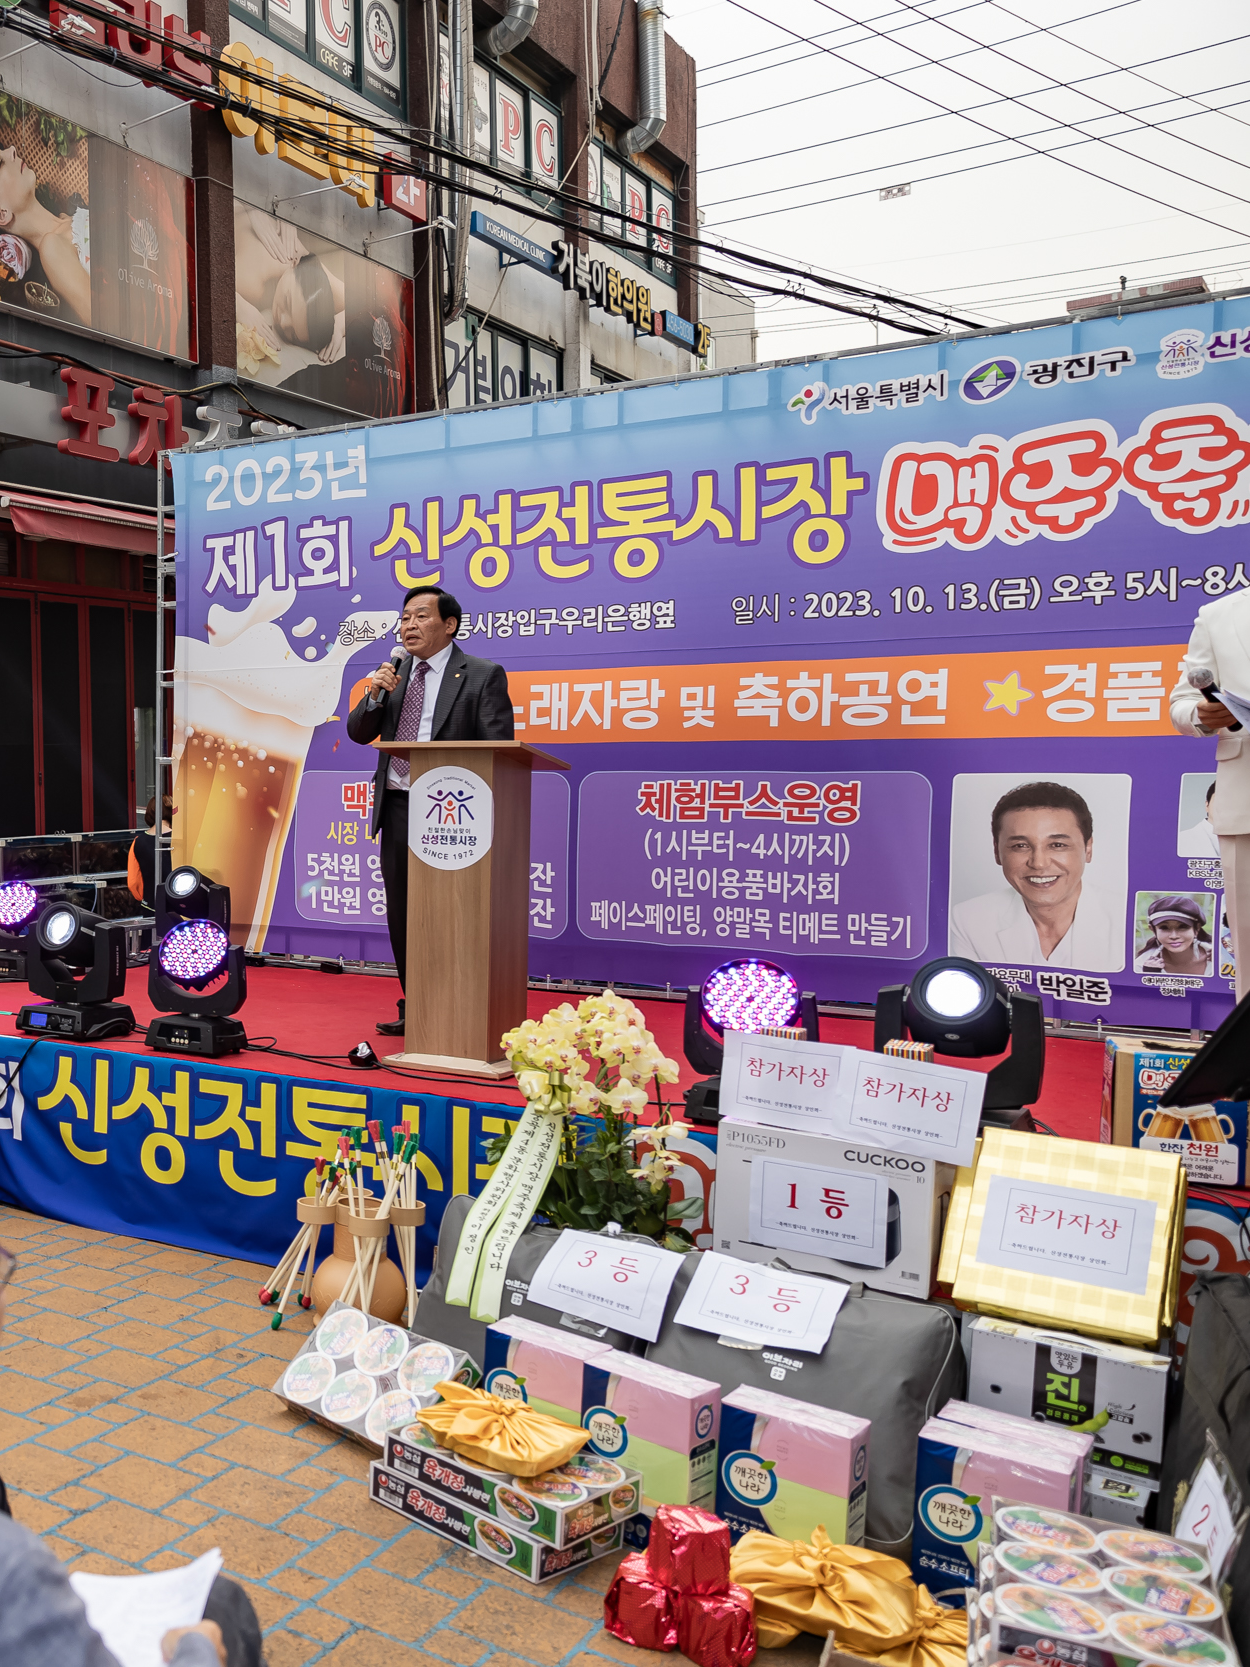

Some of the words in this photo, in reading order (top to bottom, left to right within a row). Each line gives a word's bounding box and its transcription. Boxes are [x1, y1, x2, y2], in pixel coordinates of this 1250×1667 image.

[374, 33, 390, 61] PC
[320, 48, 339, 72] CAFE
[342, 61, 353, 78] 3F
[499, 93, 555, 178] PC
[486, 220, 509, 244] KOREAN
[508, 231, 530, 253] MEDICAL
[530, 242, 546, 263] CLINIC
[117, 268, 145, 289] Olive
[147, 276, 173, 299] Aroma
[552, 240, 651, 332] 거북이한의원
[698, 323, 711, 357] 2F
[364, 358, 382, 374] Olive
[383, 363, 401, 380] Aroma
[1027, 350, 1132, 387] 광진구
[828, 373, 946, 414] 서울특별시
[204, 443, 369, 511] 2023년
[204, 516, 354, 597] 제1회
[371, 456, 865, 590] 신성전통시장
[730, 593, 780, 626] 일시
[803, 591, 882, 620] 2023.
[890, 585, 934, 614] 10.
[943, 575, 1043, 612] 13.(금)
[1049, 570, 1116, 605] 오후
[338, 620, 377, 646] 장소
[679, 684, 716, 729] 및
[732, 667, 948, 728] 축하공연
[342, 782, 375, 819] 맥
[637, 780, 862, 826] 체험부스운영
[326, 821, 359, 846] 시장
[420, 833, 478, 847] 신성전통시장
[643, 828, 851, 867] (1시부터~4시까지)
[307, 852, 361, 882] 5천원
[422, 846, 449, 861] SINCE
[453, 849, 475, 861] 1972
[529, 862, 556, 893] 잔
[651, 866, 841, 905] 어린이용품바자회
[308, 886, 361, 915] 1만원
[529, 898, 556, 929] 잔
[590, 899, 707, 938] 페이스페인팅,
[713, 905, 774, 941] 양말목
[778, 911, 842, 945] 티메트
[847, 912, 912, 949] 만들기
[1038, 972, 1111, 1005] 박일준
[745, 1056, 831, 1089] 참가자상
[1138, 1057, 1165, 1069] 제1회
[862, 1075, 955, 1114] 참가자상
[526, 1119, 559, 1183] 신성전통시장
[731, 1131, 787, 1150] P1055FD
[1159, 1142, 1184, 1155] 한잔
[1186, 1142, 1219, 1158] 천원
[843, 1149, 926, 1174] CUCKOO
[507, 1182, 535, 1221] 맥주축제
[785, 1182, 800, 1210] 1
[818, 1186, 850, 1220] 등
[1014, 1202, 1123, 1240] 참가자상
[577, 1249, 598, 1268] 3
[609, 1256, 640, 1283] 등
[1050, 1250, 1087, 1262] 신성전통시장
[729, 1273, 750, 1296] 3
[767, 1286, 802, 1314] 등
[761, 1351, 804, 1369] 이브자리
[1055, 1350, 1079, 1364] 맛있는
[1056, 1358, 1075, 1371] 두유
[494, 1381, 522, 1400] 깨끗한
[592, 1419, 621, 1440] 깨끗한
[595, 1432, 616, 1449] 나라
[403, 1449, 421, 1465] 농심
[387, 1478, 405, 1495] 농심
[423, 1457, 466, 1493] 육개장
[462, 1484, 491, 1505] 사발면
[734, 1464, 768, 1486] 깨끗한
[738, 1479, 762, 1496] 나라
[406, 1488, 448, 1524] 육개장
[443, 1515, 472, 1537] 사발면
[932, 1499, 972, 1522] 깨끗한
[938, 1513, 965, 1532] 나라
[567, 1514, 595, 1539] 육개장
[918, 1555, 970, 1581] 순수소프티
